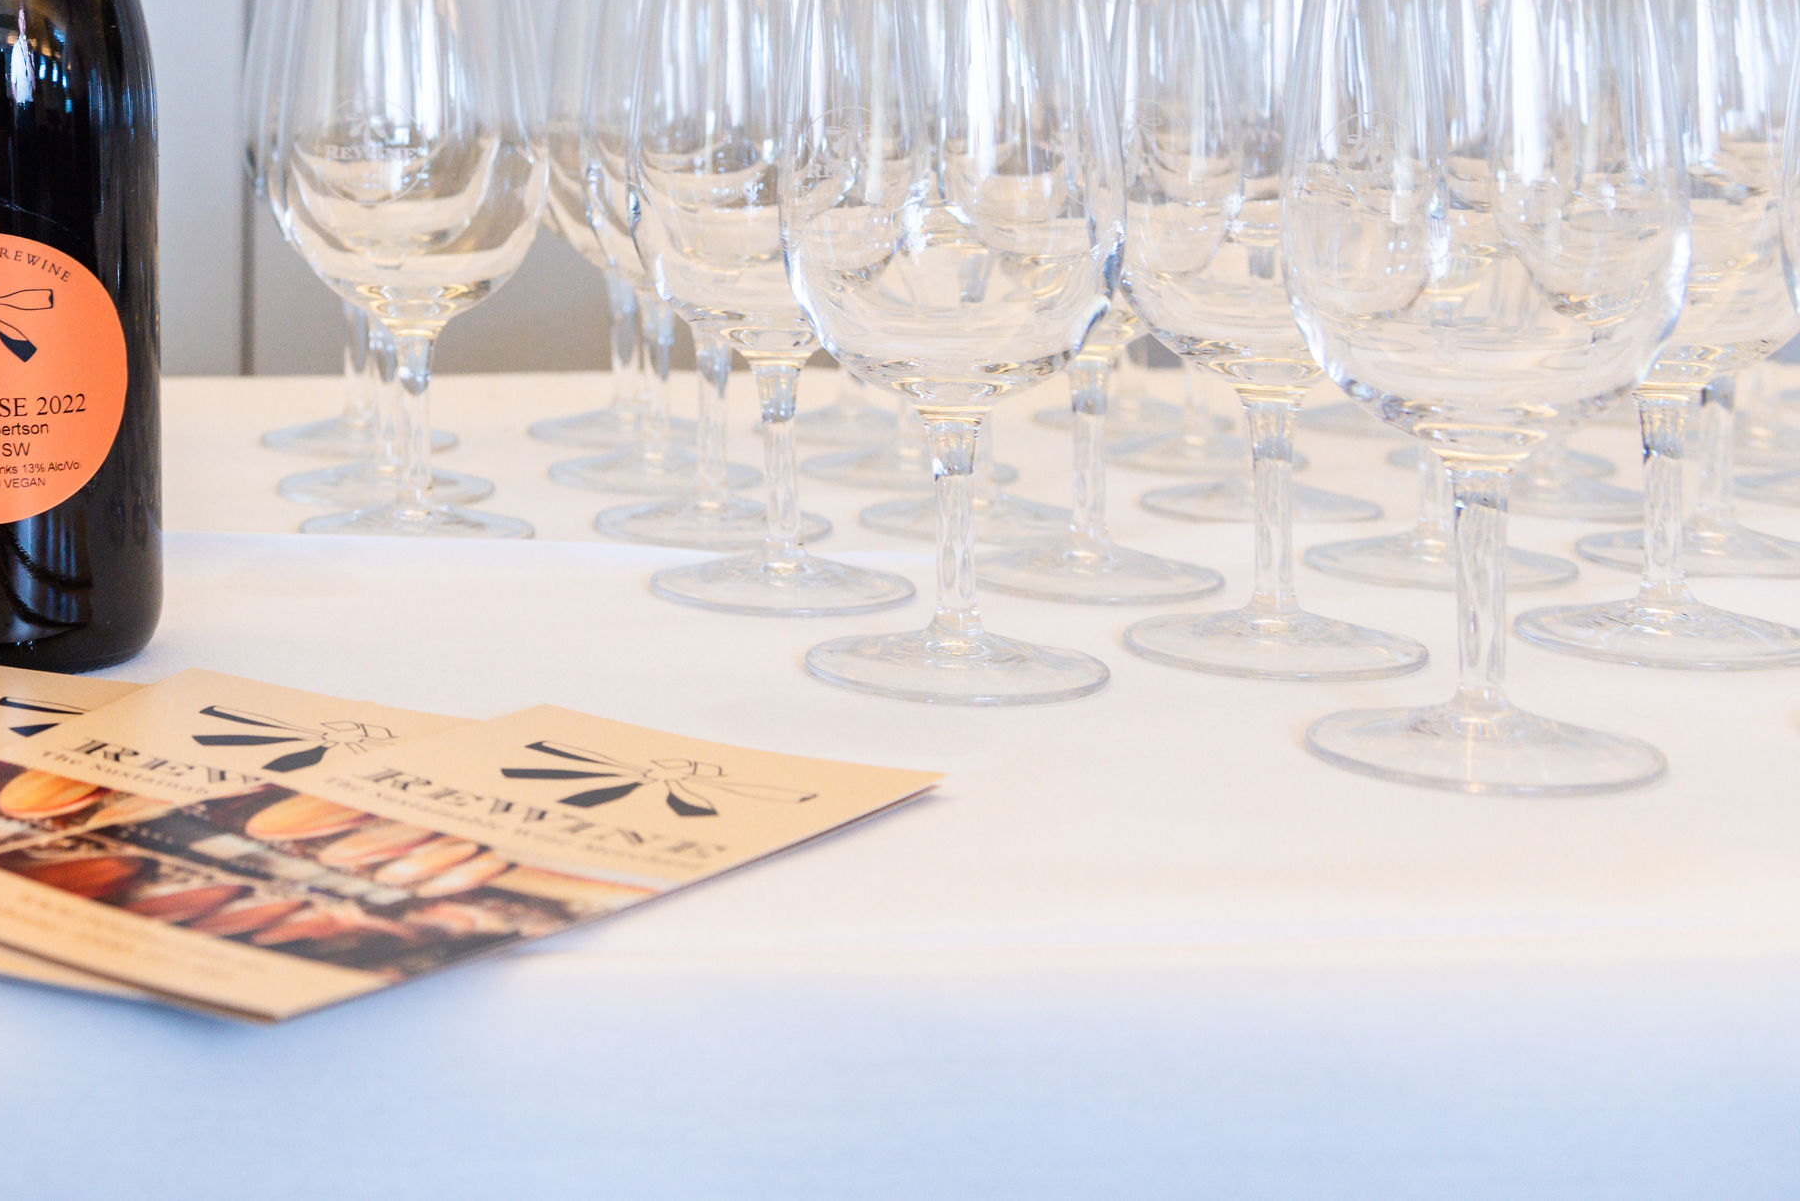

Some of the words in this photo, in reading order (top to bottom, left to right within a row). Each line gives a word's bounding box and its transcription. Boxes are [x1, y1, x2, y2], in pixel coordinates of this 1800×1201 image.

[0, 248, 72, 282] REWINE
[36, 393, 86, 416] 2022
[22, 463, 45, 473] 13%
[47, 460, 80, 471] Alc/Vo
[3, 477, 46, 489] VEGAN
[41, 749, 83, 766] The
[355, 768, 727, 858] REWINE
